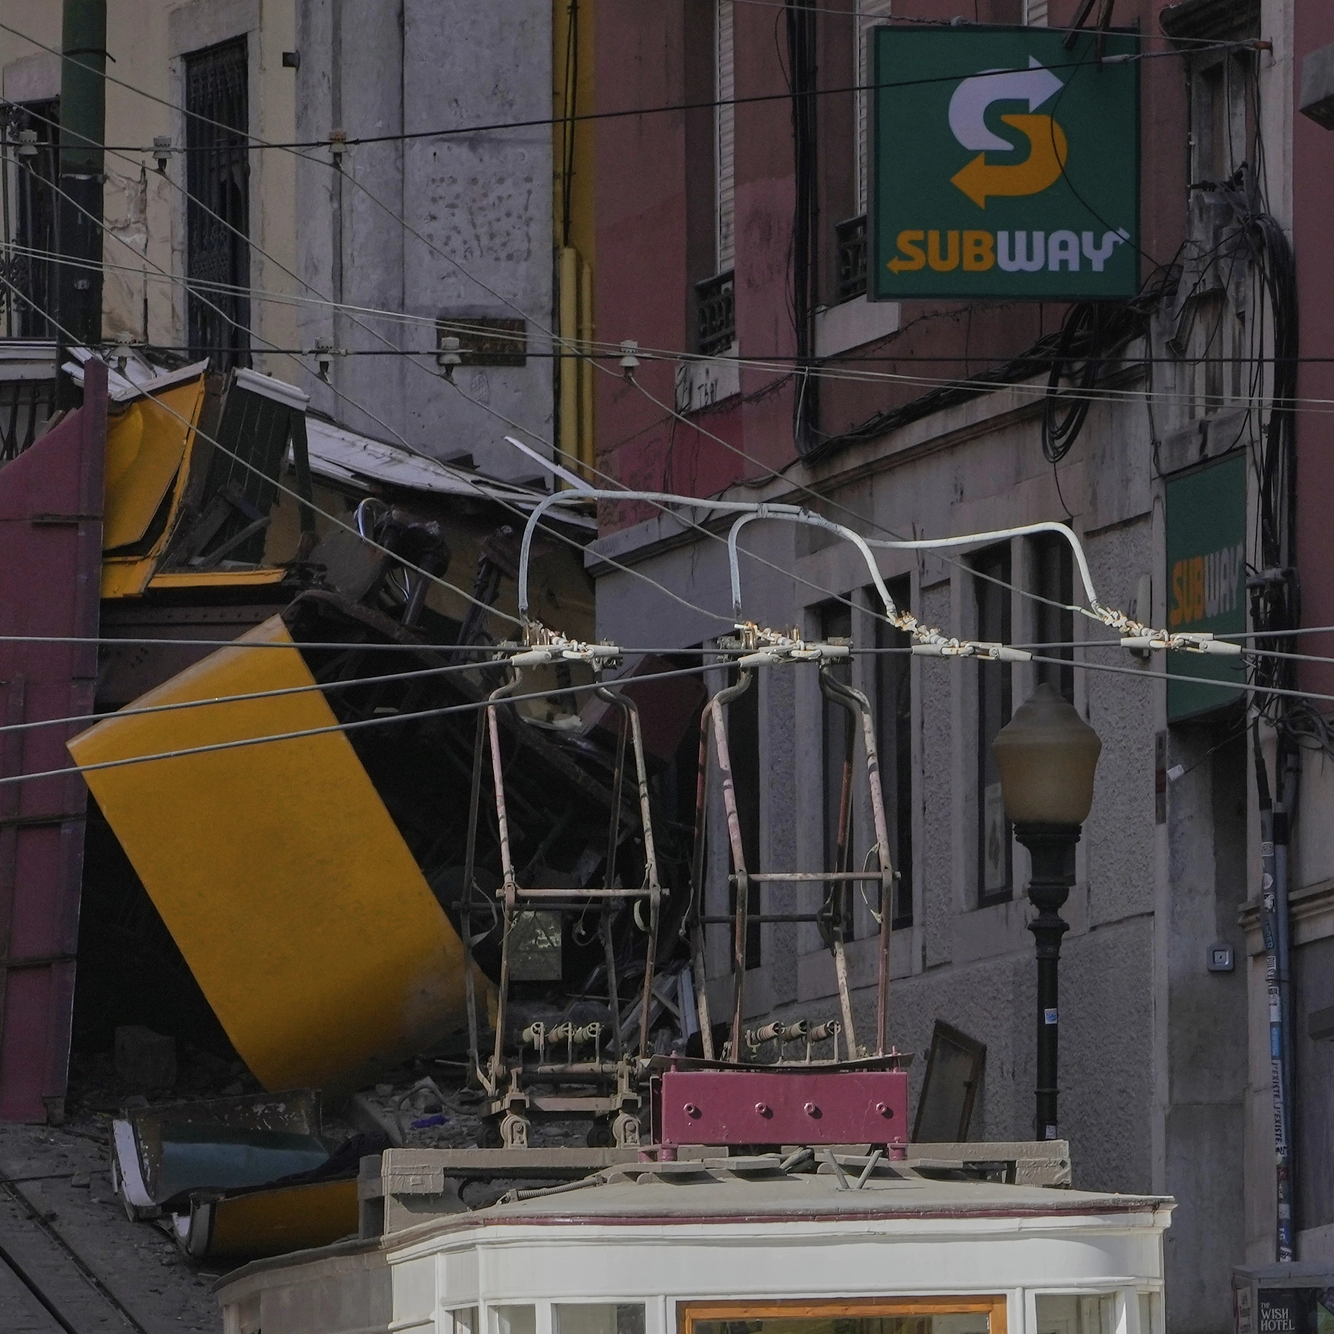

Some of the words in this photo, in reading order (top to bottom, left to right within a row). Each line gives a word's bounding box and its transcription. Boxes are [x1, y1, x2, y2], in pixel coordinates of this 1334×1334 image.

[886, 227, 1131, 274] SUBWAY
[1170, 542, 1244, 626] SUBWAY
[1260, 1320, 1296, 1332] HOTEL
[1261, 1308, 1289, 1320] WISH
